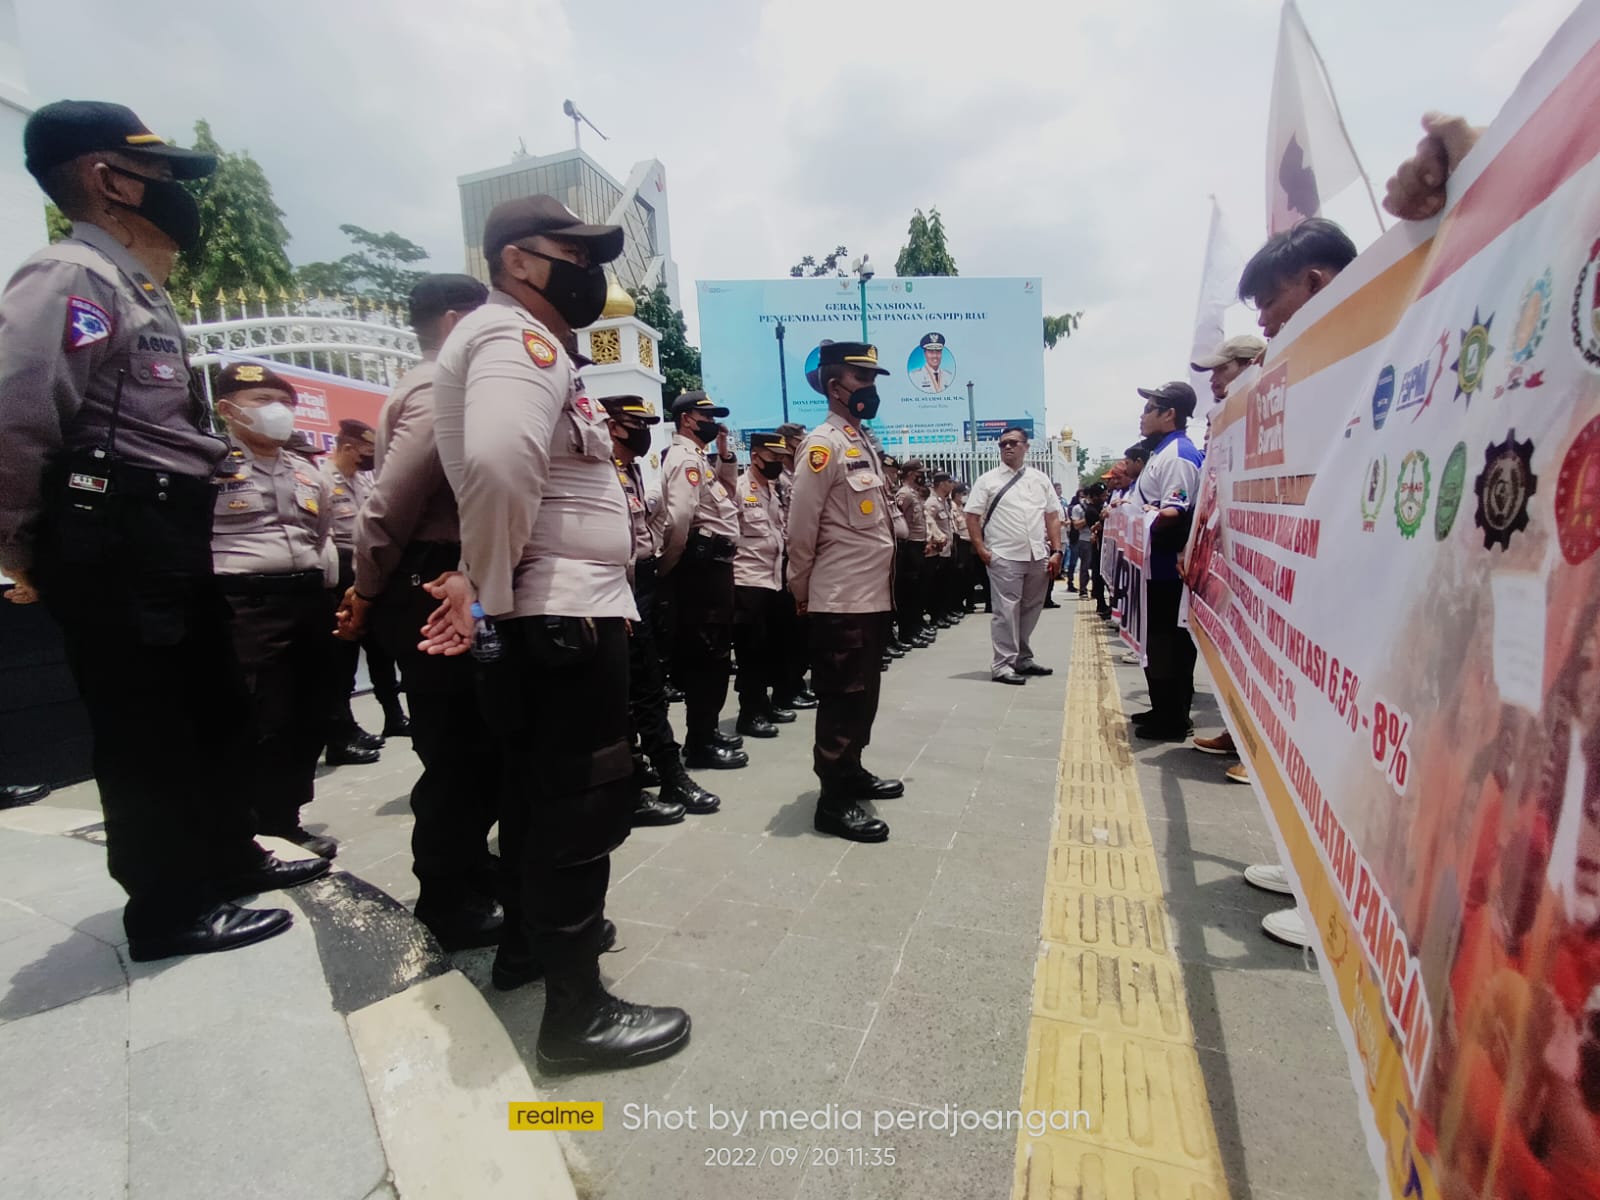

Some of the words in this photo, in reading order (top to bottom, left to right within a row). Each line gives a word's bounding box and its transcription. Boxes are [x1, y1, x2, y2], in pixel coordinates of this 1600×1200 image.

[759, 313, 839, 323] PENGENDALIAN
[842, 313, 883, 321] INFASI
[884, 313, 923, 321] PANGAN
[925, 312, 963, 321] (GNPIP)
[965, 312, 988, 320] RIAU
[825, 303, 873, 311] GERAKN
[875, 302, 925, 310] NASIONAL
[138, 335, 178, 354] AGUS
[1256, 376, 1286, 424] Partai
[1257, 415, 1284, 455] Buruh
[1293, 517, 1320, 559] BBM
[1275, 565, 1296, 605] LAW
[1285, 623, 1327, 693] INFLASI
[1328, 657, 1361, 733] 6,5%
[1372, 701, 1408, 786] 8%
[1285, 737, 1357, 902] KEDAULATAN
[1353, 863, 1429, 1087] PANGAN
